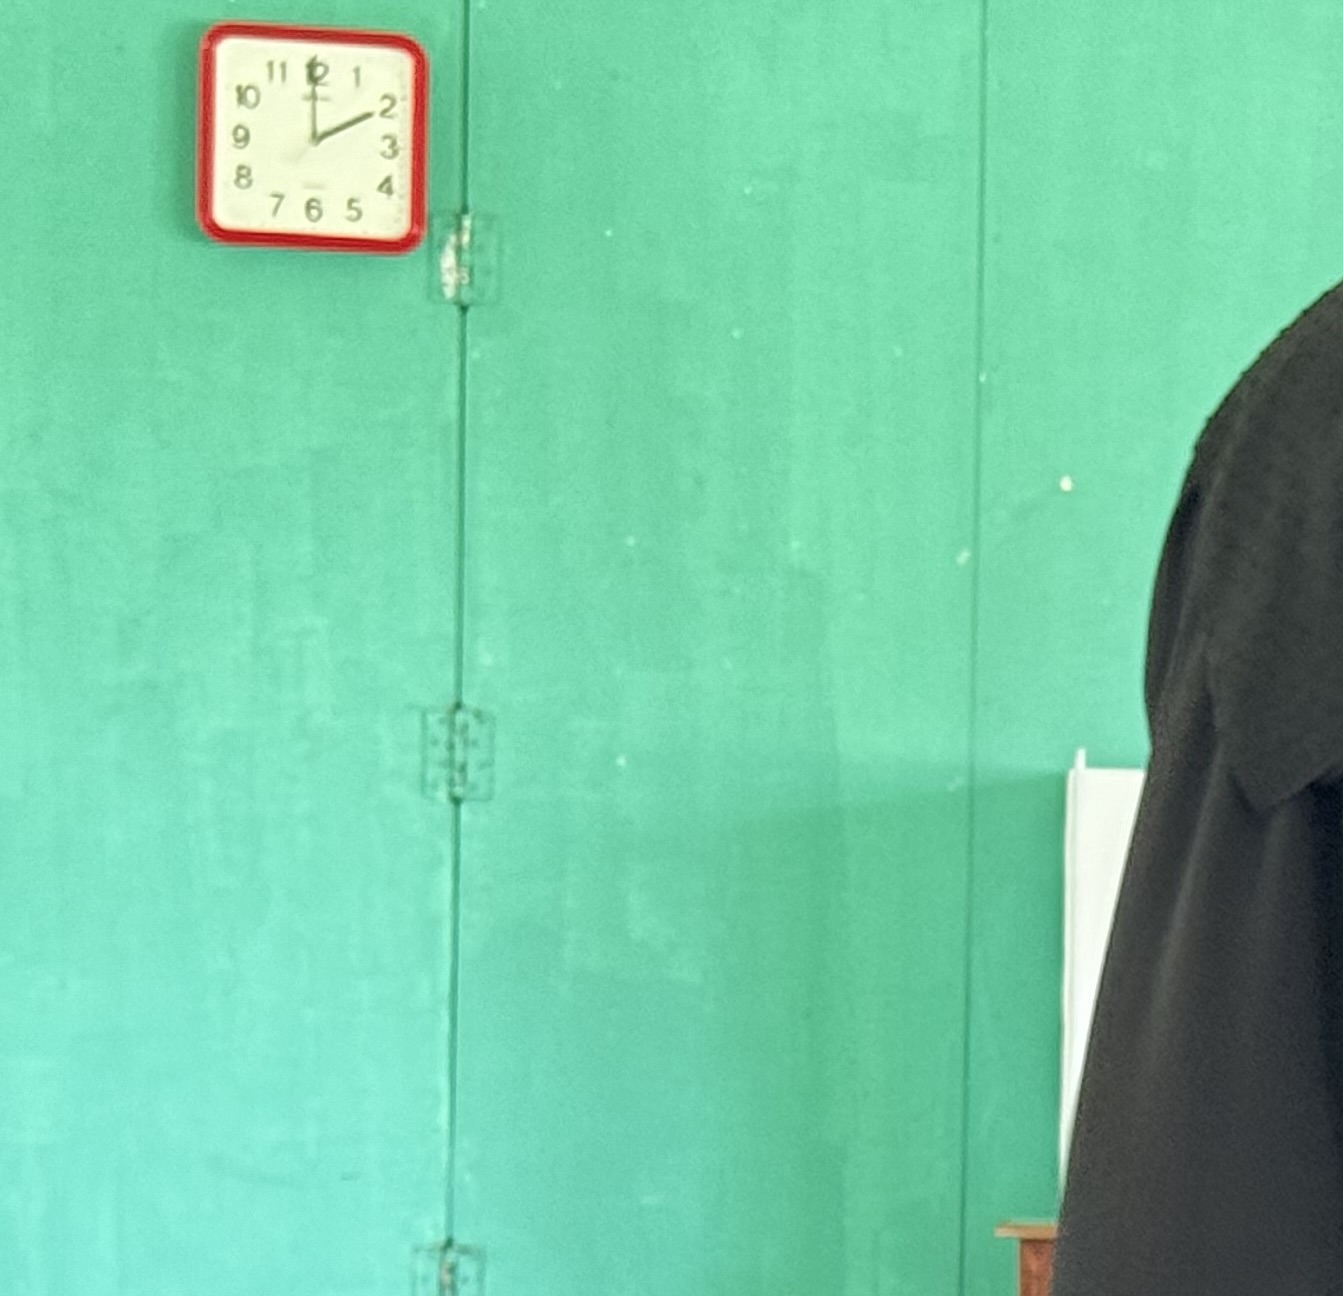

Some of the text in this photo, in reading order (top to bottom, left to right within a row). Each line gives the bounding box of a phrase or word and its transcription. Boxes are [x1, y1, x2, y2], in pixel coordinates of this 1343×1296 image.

[267, 60, 287, 83] 11
[353, 66, 361, 88] 1
[236, 84, 261, 110] 10
[379, 94, 397, 118] 2
[232, 124, 250, 149] 9
[380, 134, 399, 160] 3
[234, 165, 253, 190] 8
[377, 175, 394, 196] 4
[270, 194, 285, 218] 7
[304, 198, 323, 223] 6
[345, 198, 362, 222] 5
